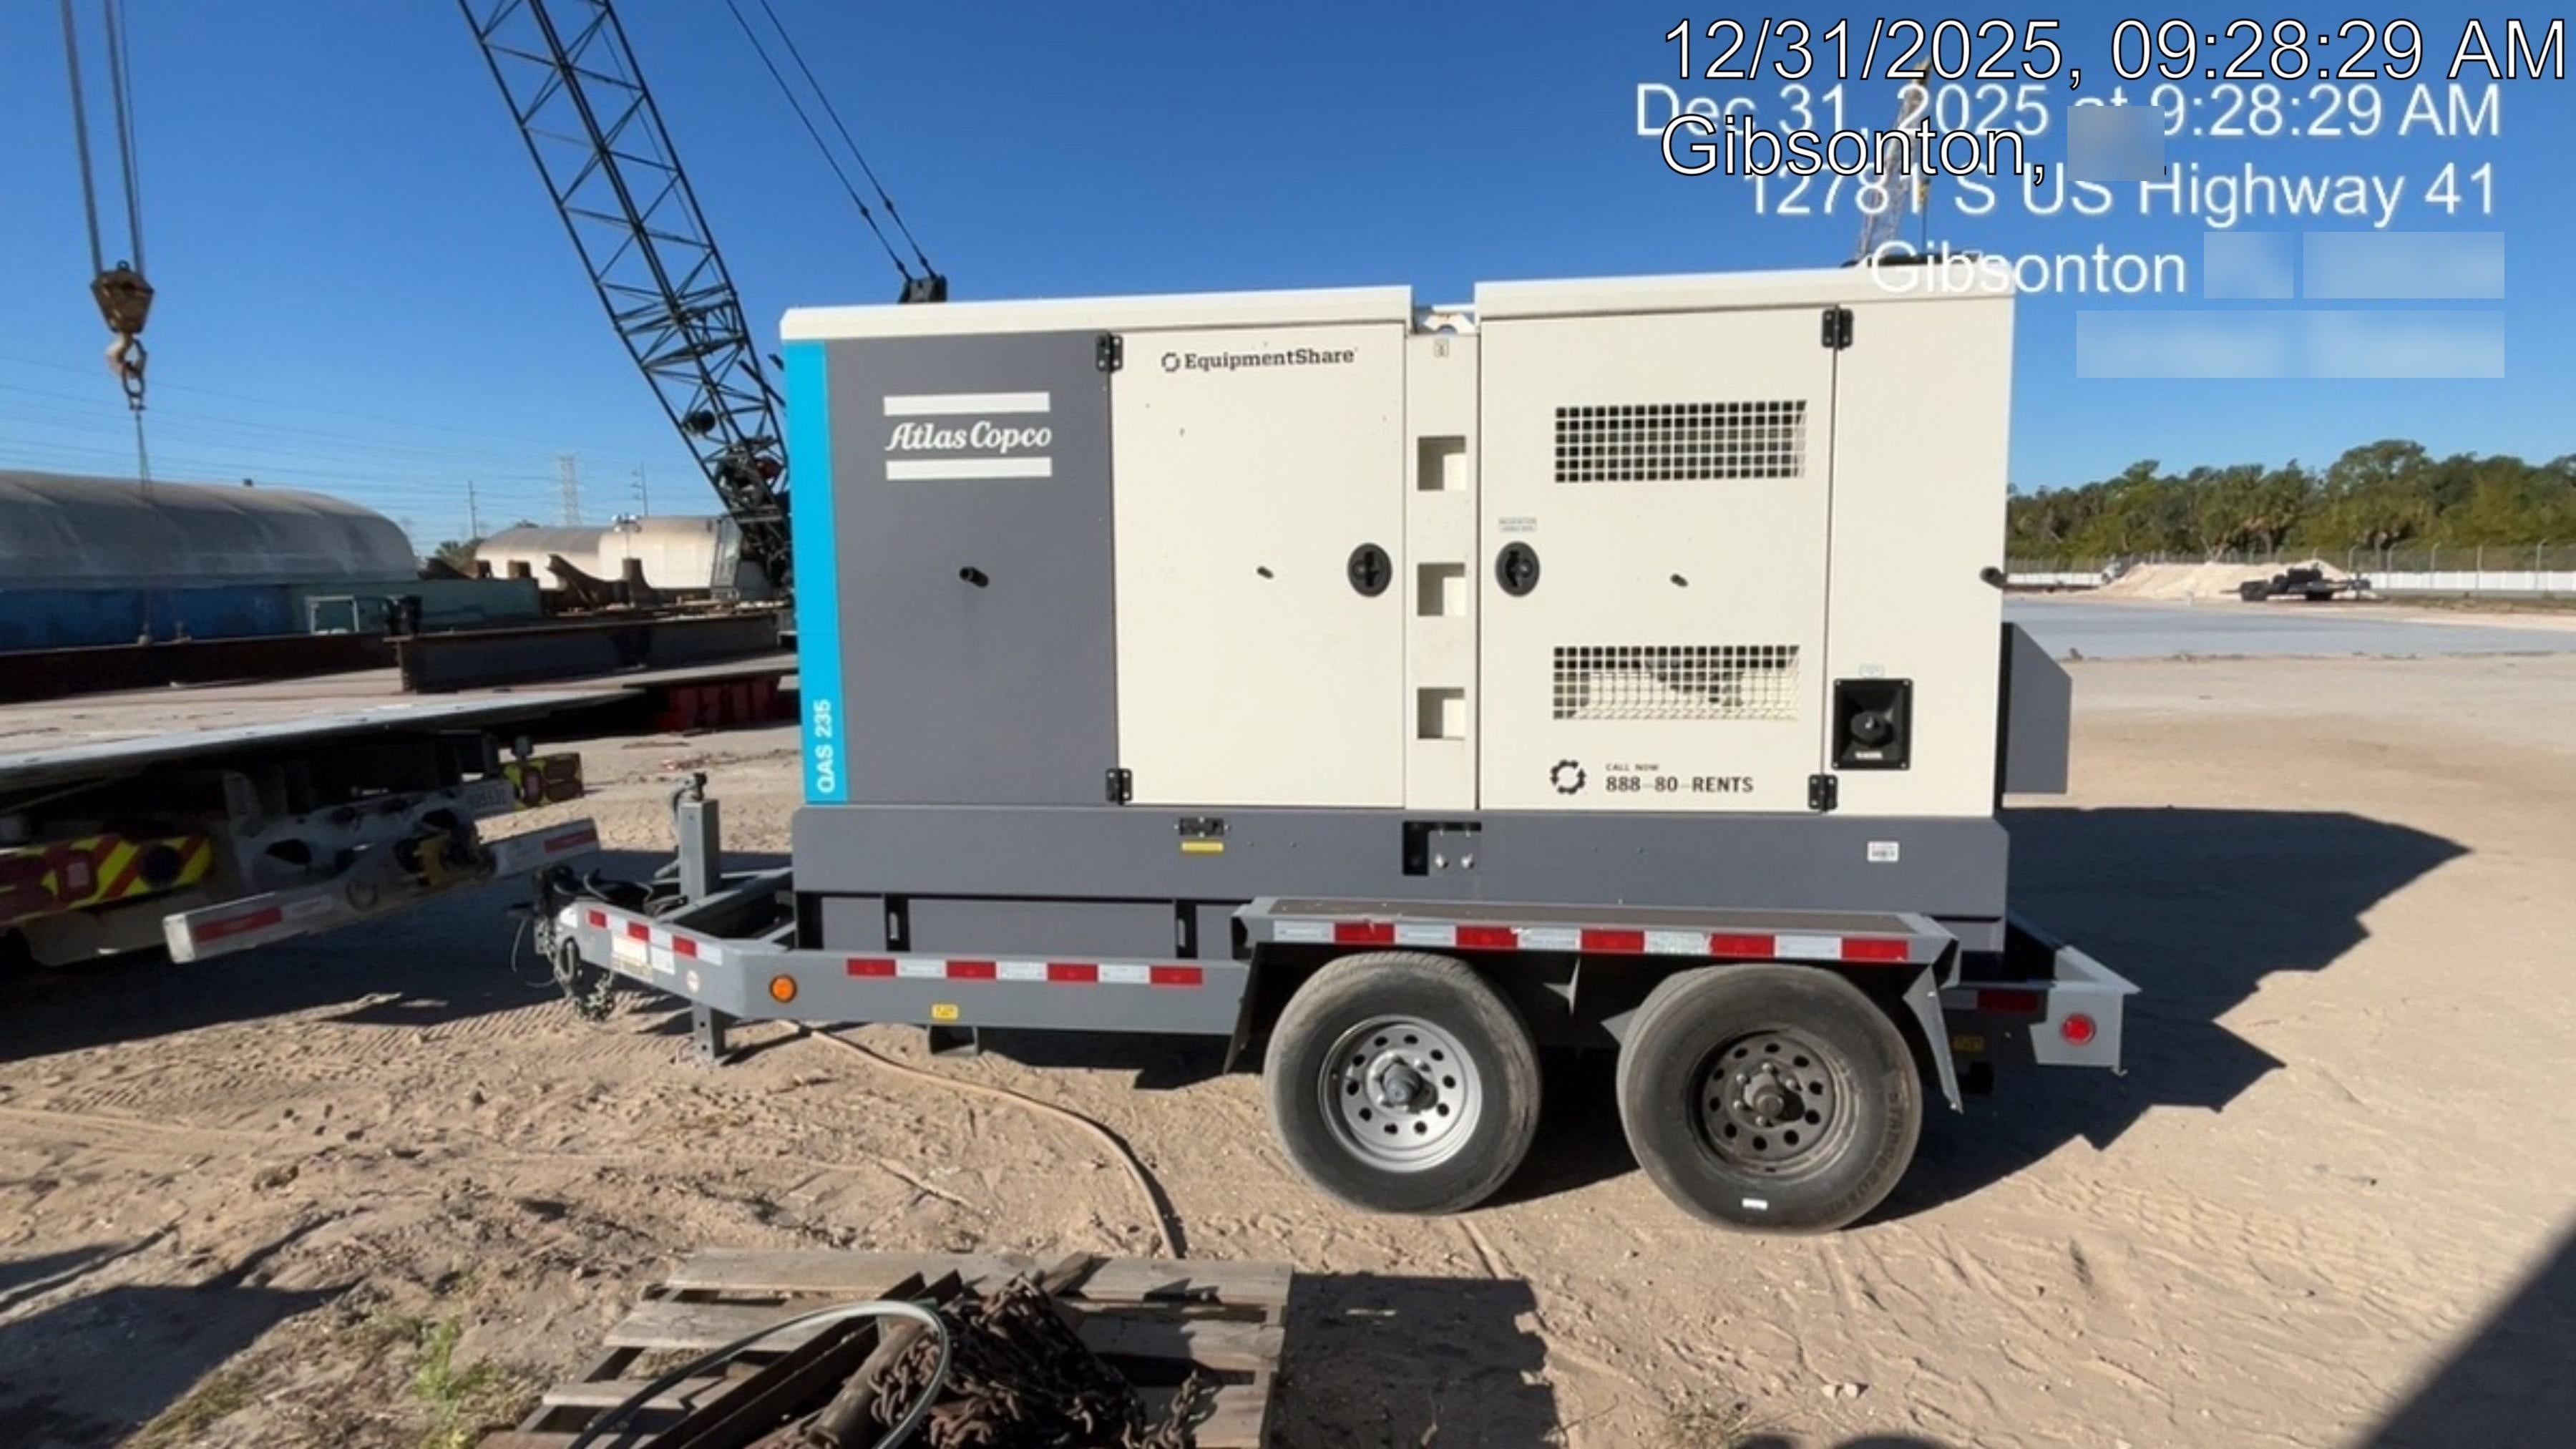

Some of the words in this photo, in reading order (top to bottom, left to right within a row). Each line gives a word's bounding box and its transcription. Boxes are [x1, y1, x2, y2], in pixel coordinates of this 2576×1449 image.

[1184, 347, 1355, 372] EquipmentShare
[884, 421, 967, 452] Atlas
[970, 419, 1053, 454] Copco
[813, 698, 832, 738] 235
[814, 744, 836, 794] QAS
